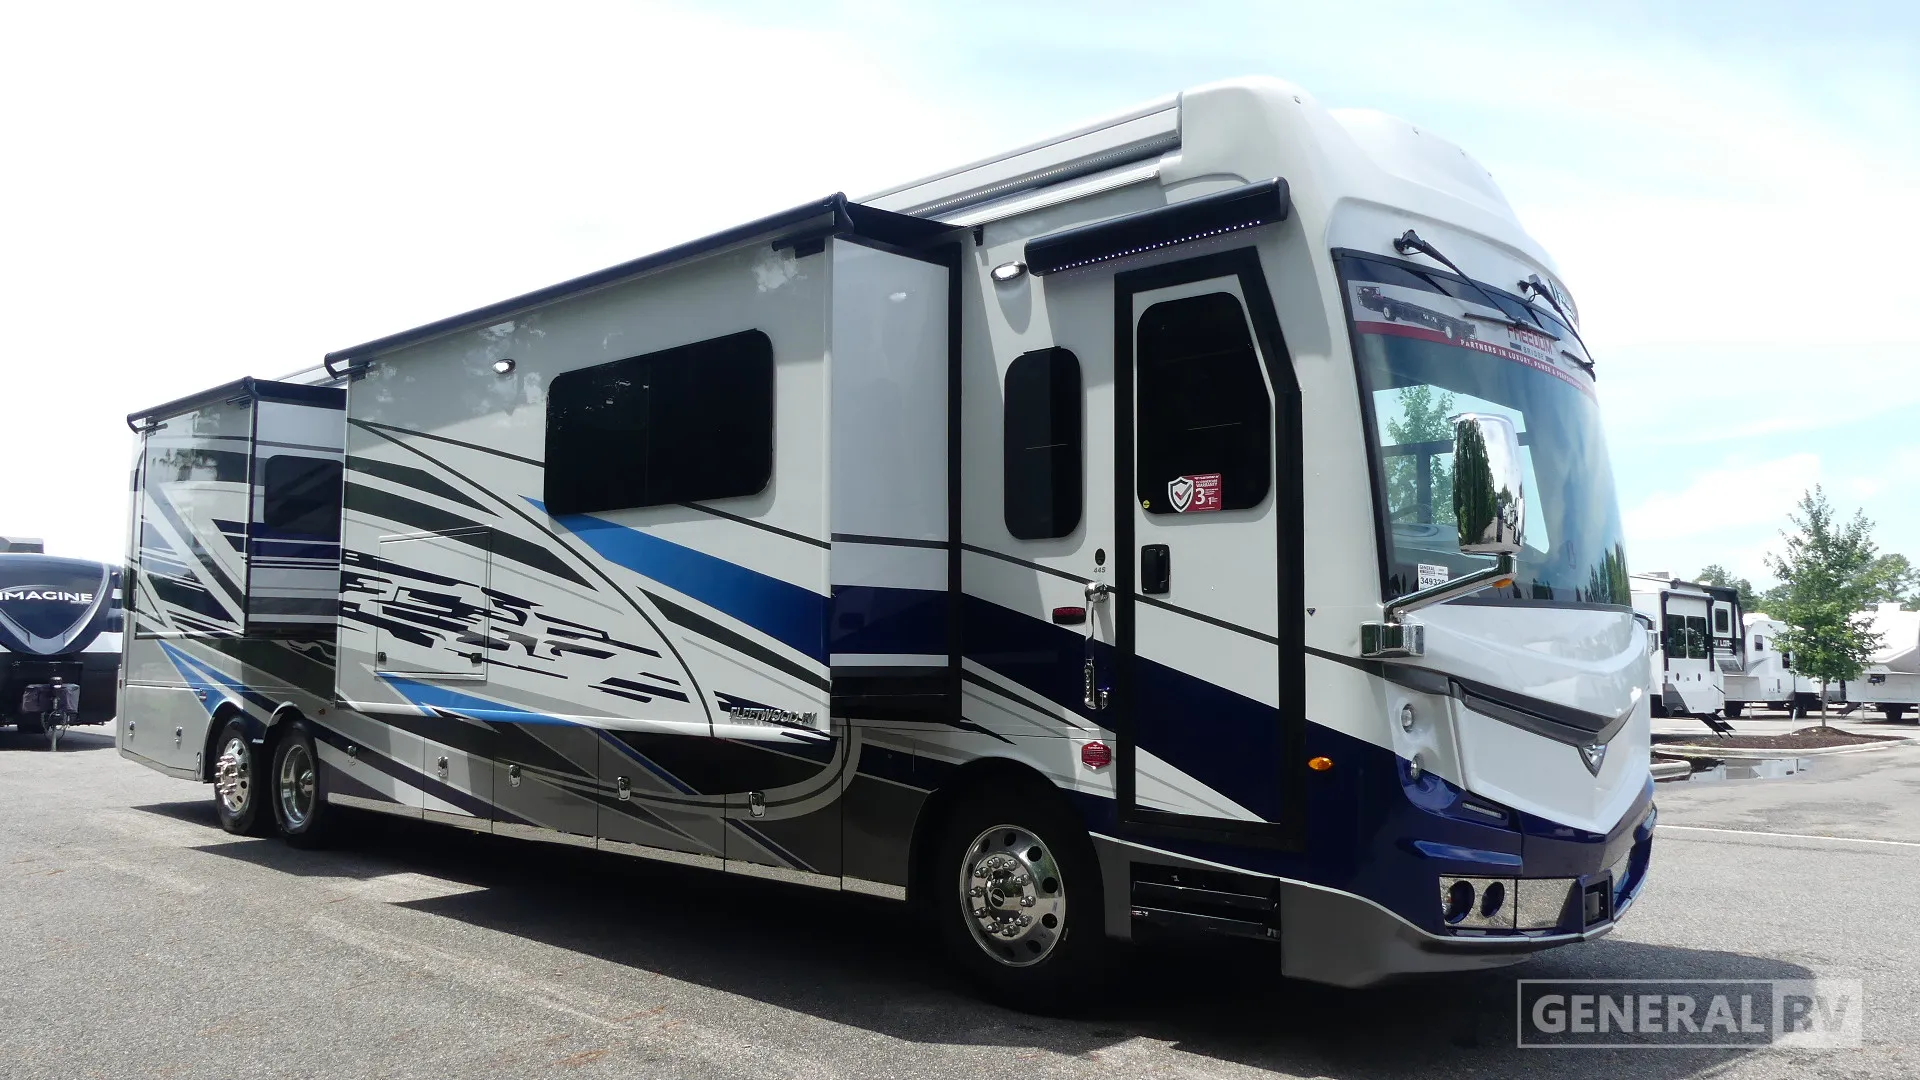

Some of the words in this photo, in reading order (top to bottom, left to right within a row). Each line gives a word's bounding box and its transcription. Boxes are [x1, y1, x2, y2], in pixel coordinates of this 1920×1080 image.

[1460, 339, 1497, 354] PARTNERS
[1499, 348, 1506, 357] IN
[1195, 487, 1206, 505] 3
[0, 591, 93, 602] IMAGINE
